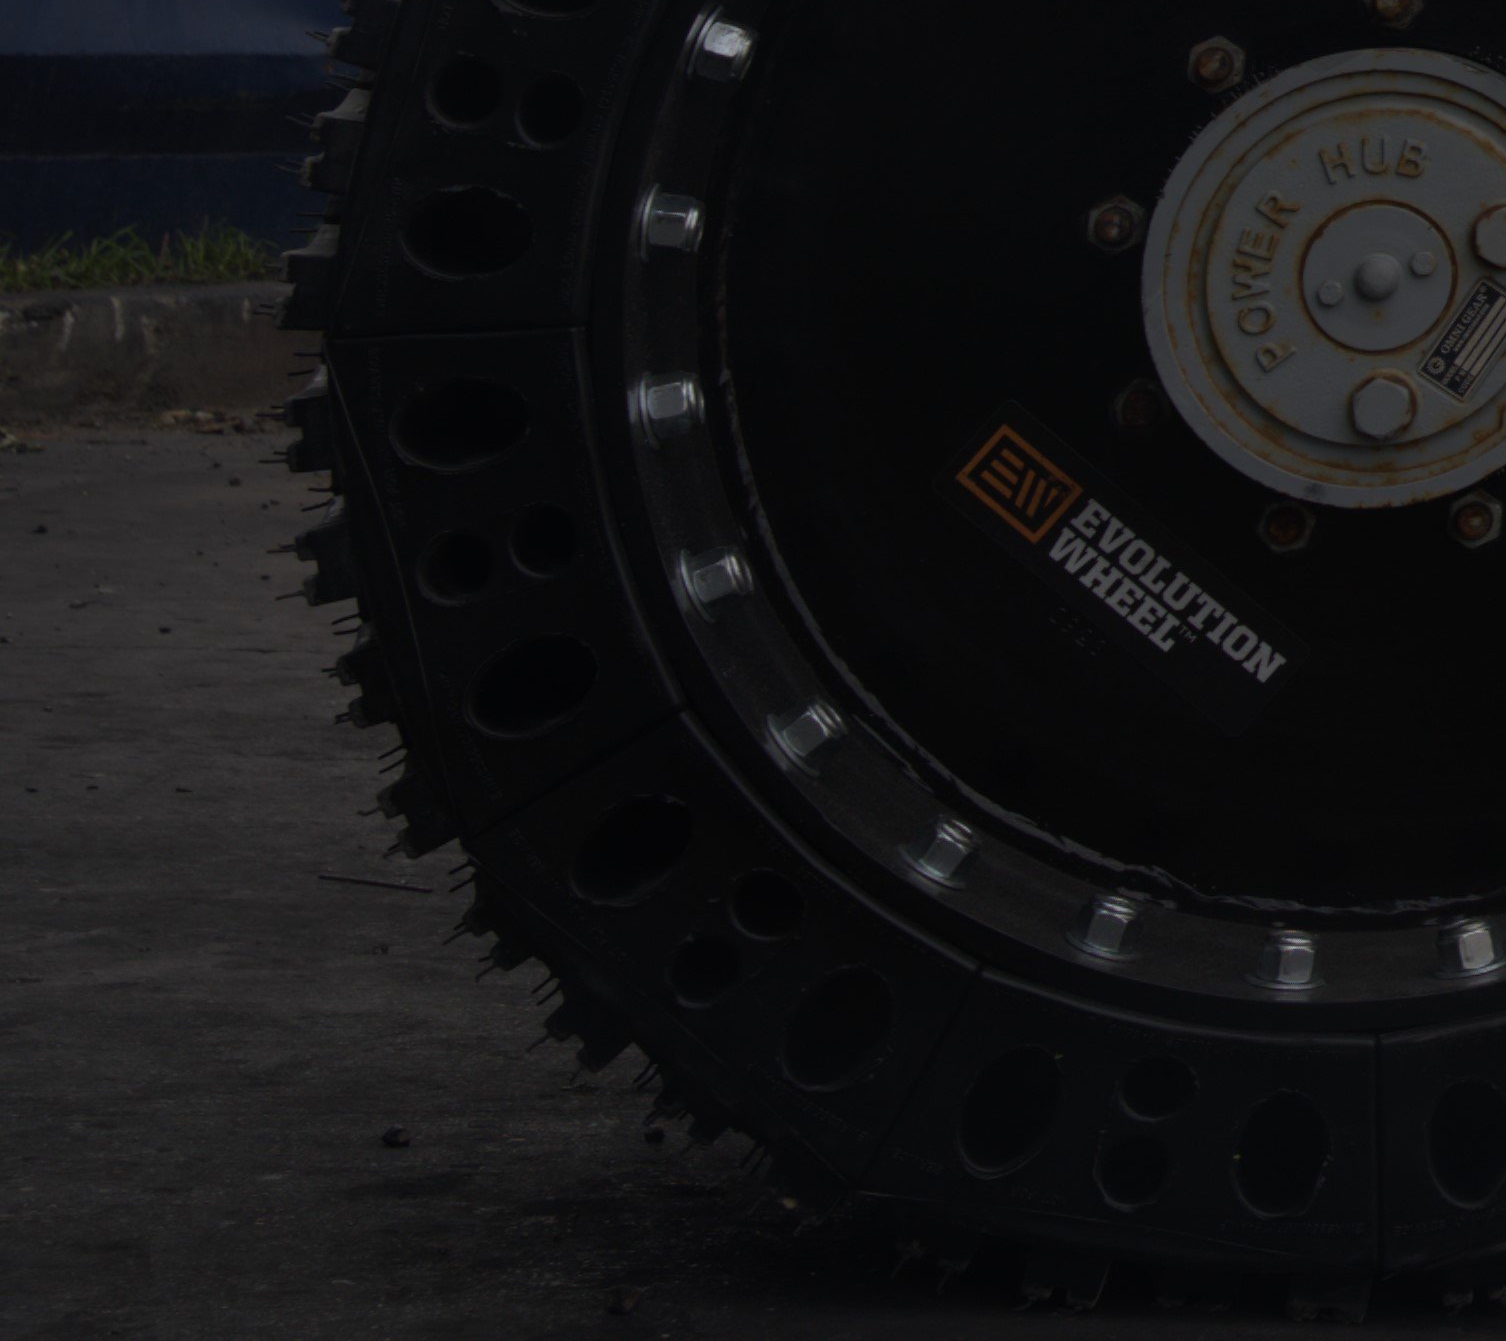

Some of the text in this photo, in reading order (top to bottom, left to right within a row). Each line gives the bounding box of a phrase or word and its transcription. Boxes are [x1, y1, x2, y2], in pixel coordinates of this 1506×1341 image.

[1231, 137, 1427, 373] POWER HUB
[1440, 318, 1469, 355] OMNI
[1461, 292, 1489, 321] GEAR
[1049, 526, 1182, 654] WHEEL
[1068, 497, 1287, 684] EVOLUTION
